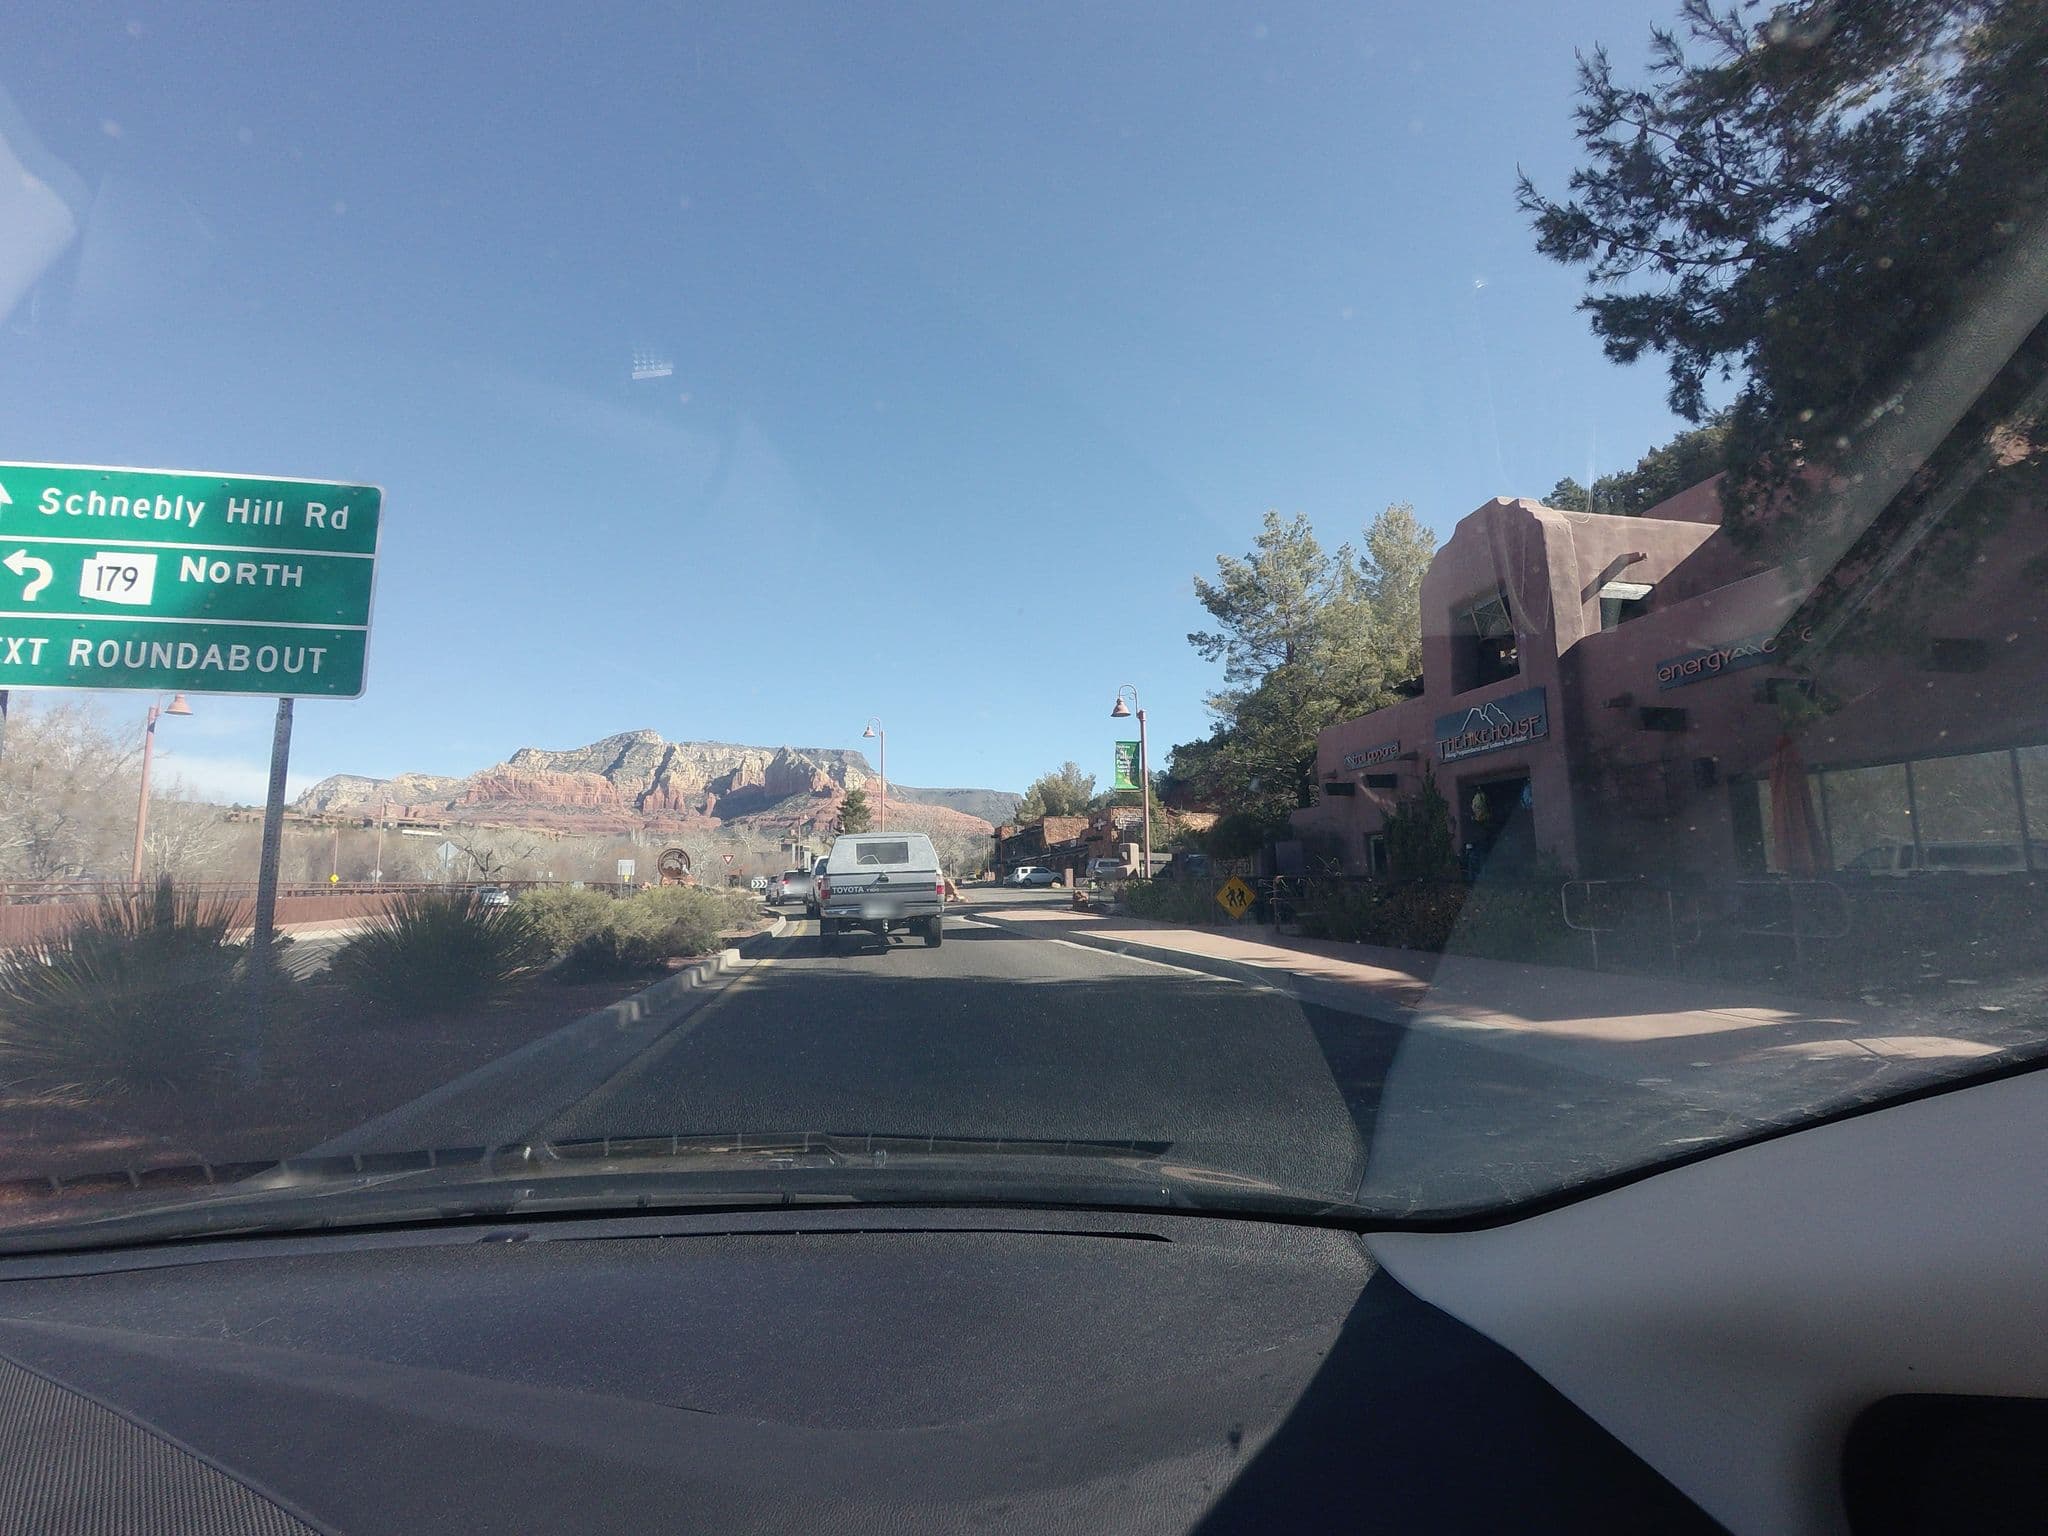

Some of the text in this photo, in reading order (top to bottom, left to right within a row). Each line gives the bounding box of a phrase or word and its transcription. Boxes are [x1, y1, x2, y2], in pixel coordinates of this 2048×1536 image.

[38, 487, 350, 530] Schnebly Hill Rd
[95, 555, 303, 592] 179 NORTH
[0, 635, 328, 675] XT ROUNDABOUT
[1436, 735, 1463, 761] THE
[1463, 729, 1489, 749] HIKE
[1489, 715, 1547, 742] HOUSE
[831, 885, 865, 895] TOYOTA
